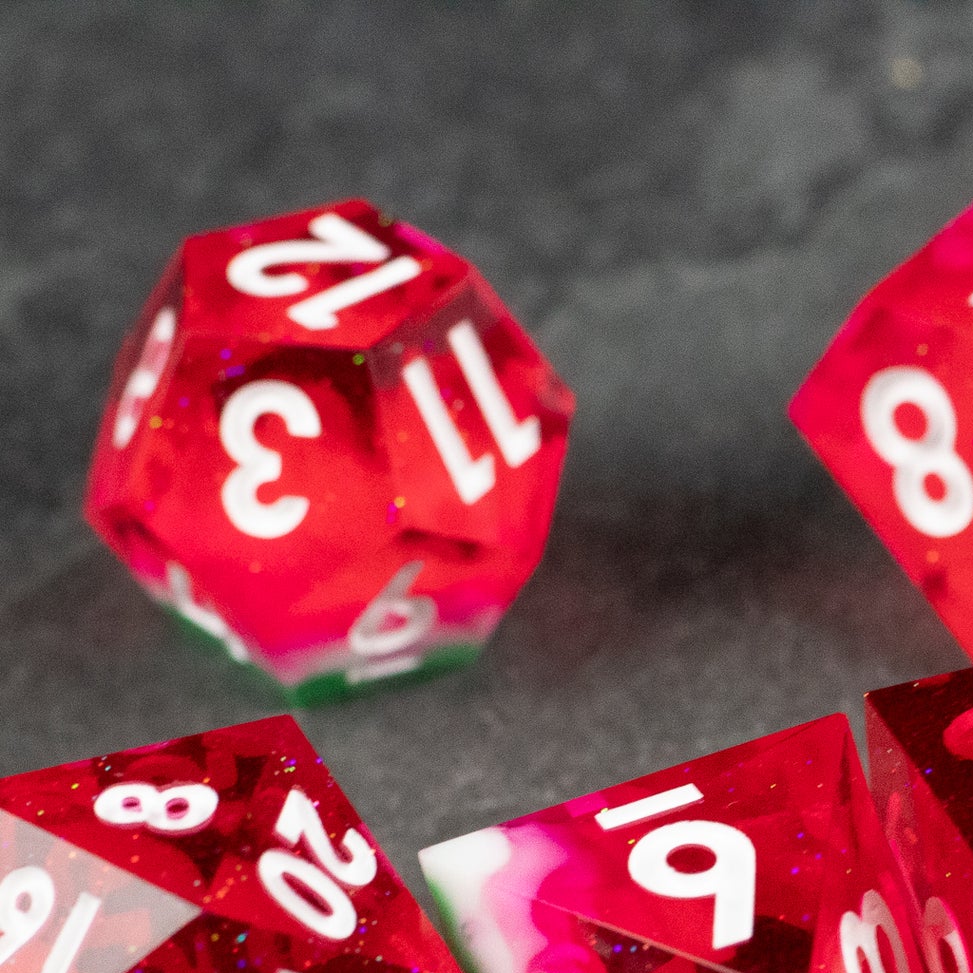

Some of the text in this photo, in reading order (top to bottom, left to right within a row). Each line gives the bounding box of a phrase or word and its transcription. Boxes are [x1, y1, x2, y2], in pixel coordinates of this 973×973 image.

[226, 213, 422, 330] 12
[219, 379, 322, 539] 3
[402, 320, 542, 505] 11
[94, 782, 219, 834] 8
[257, 789, 377, 940] 20
